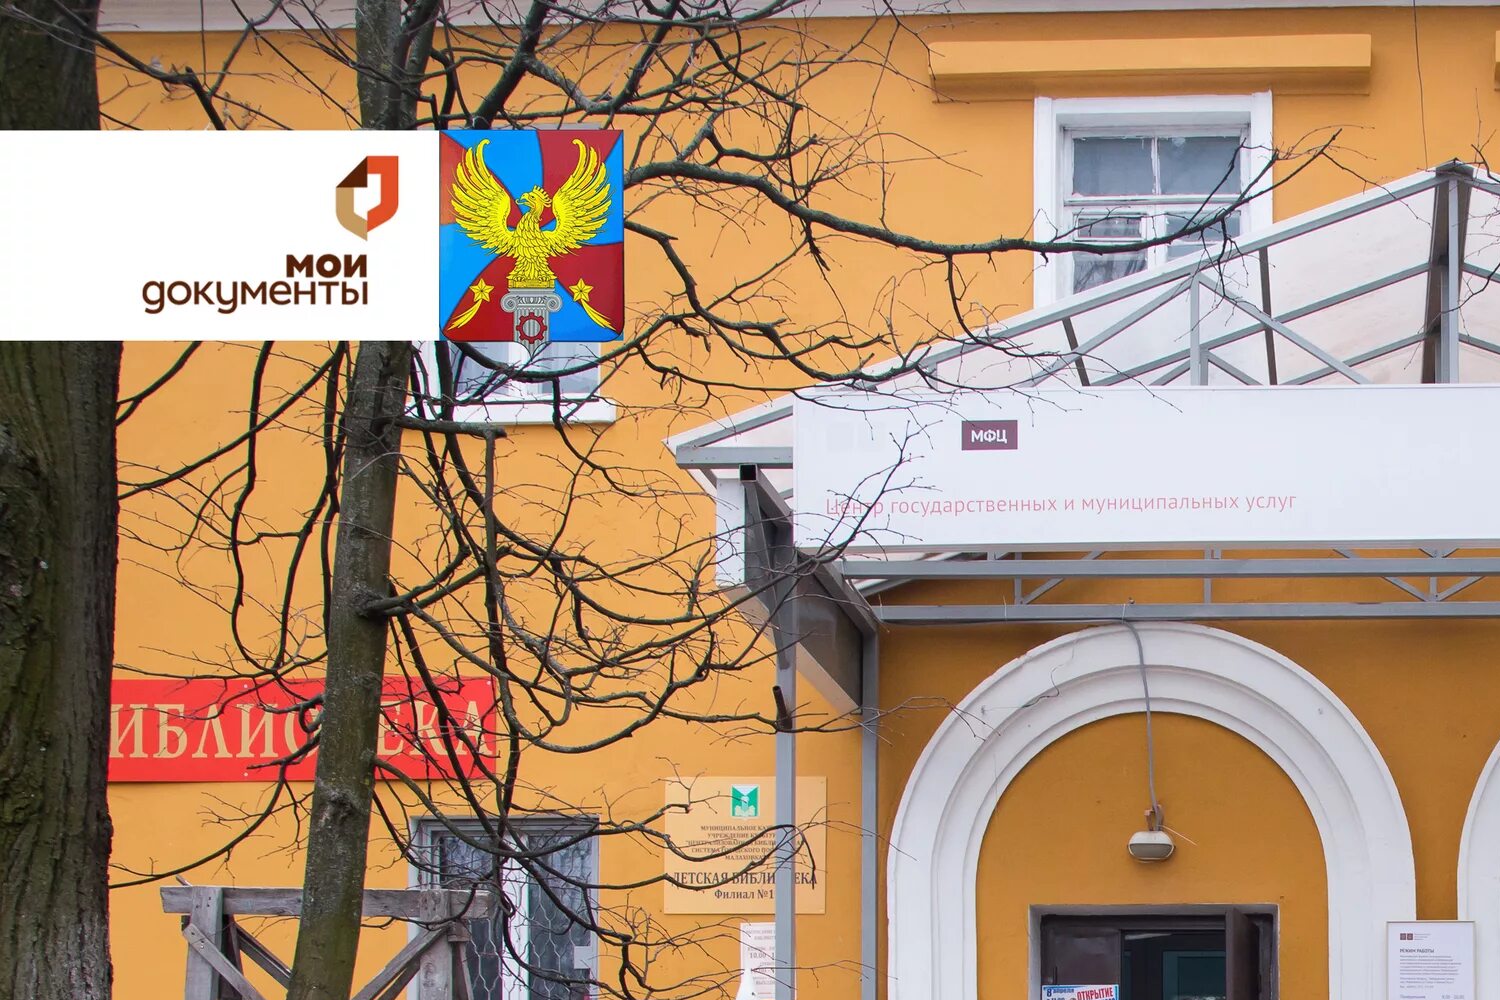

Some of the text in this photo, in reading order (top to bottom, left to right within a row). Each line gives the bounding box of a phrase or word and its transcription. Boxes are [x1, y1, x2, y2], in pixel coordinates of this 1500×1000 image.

[970, 428, 1008, 445] МФЦ
[890, 496, 1058, 518] государственных
[1063, 498, 1077, 511] и
[1080, 493, 1241, 516] муниципальных
[1244, 492, 1298, 514] услуг
[110, 701, 493, 759] ИБЛИОЕКА
[672, 871, 818, 886] ДЕТСКАЯ БИБЛИЕКА
[714, 889, 775, 900] Филиал №1
[1046, 988, 1052, 997] 8
[1077, 987, 1113, 1000] ОТКРЫТИЕ
